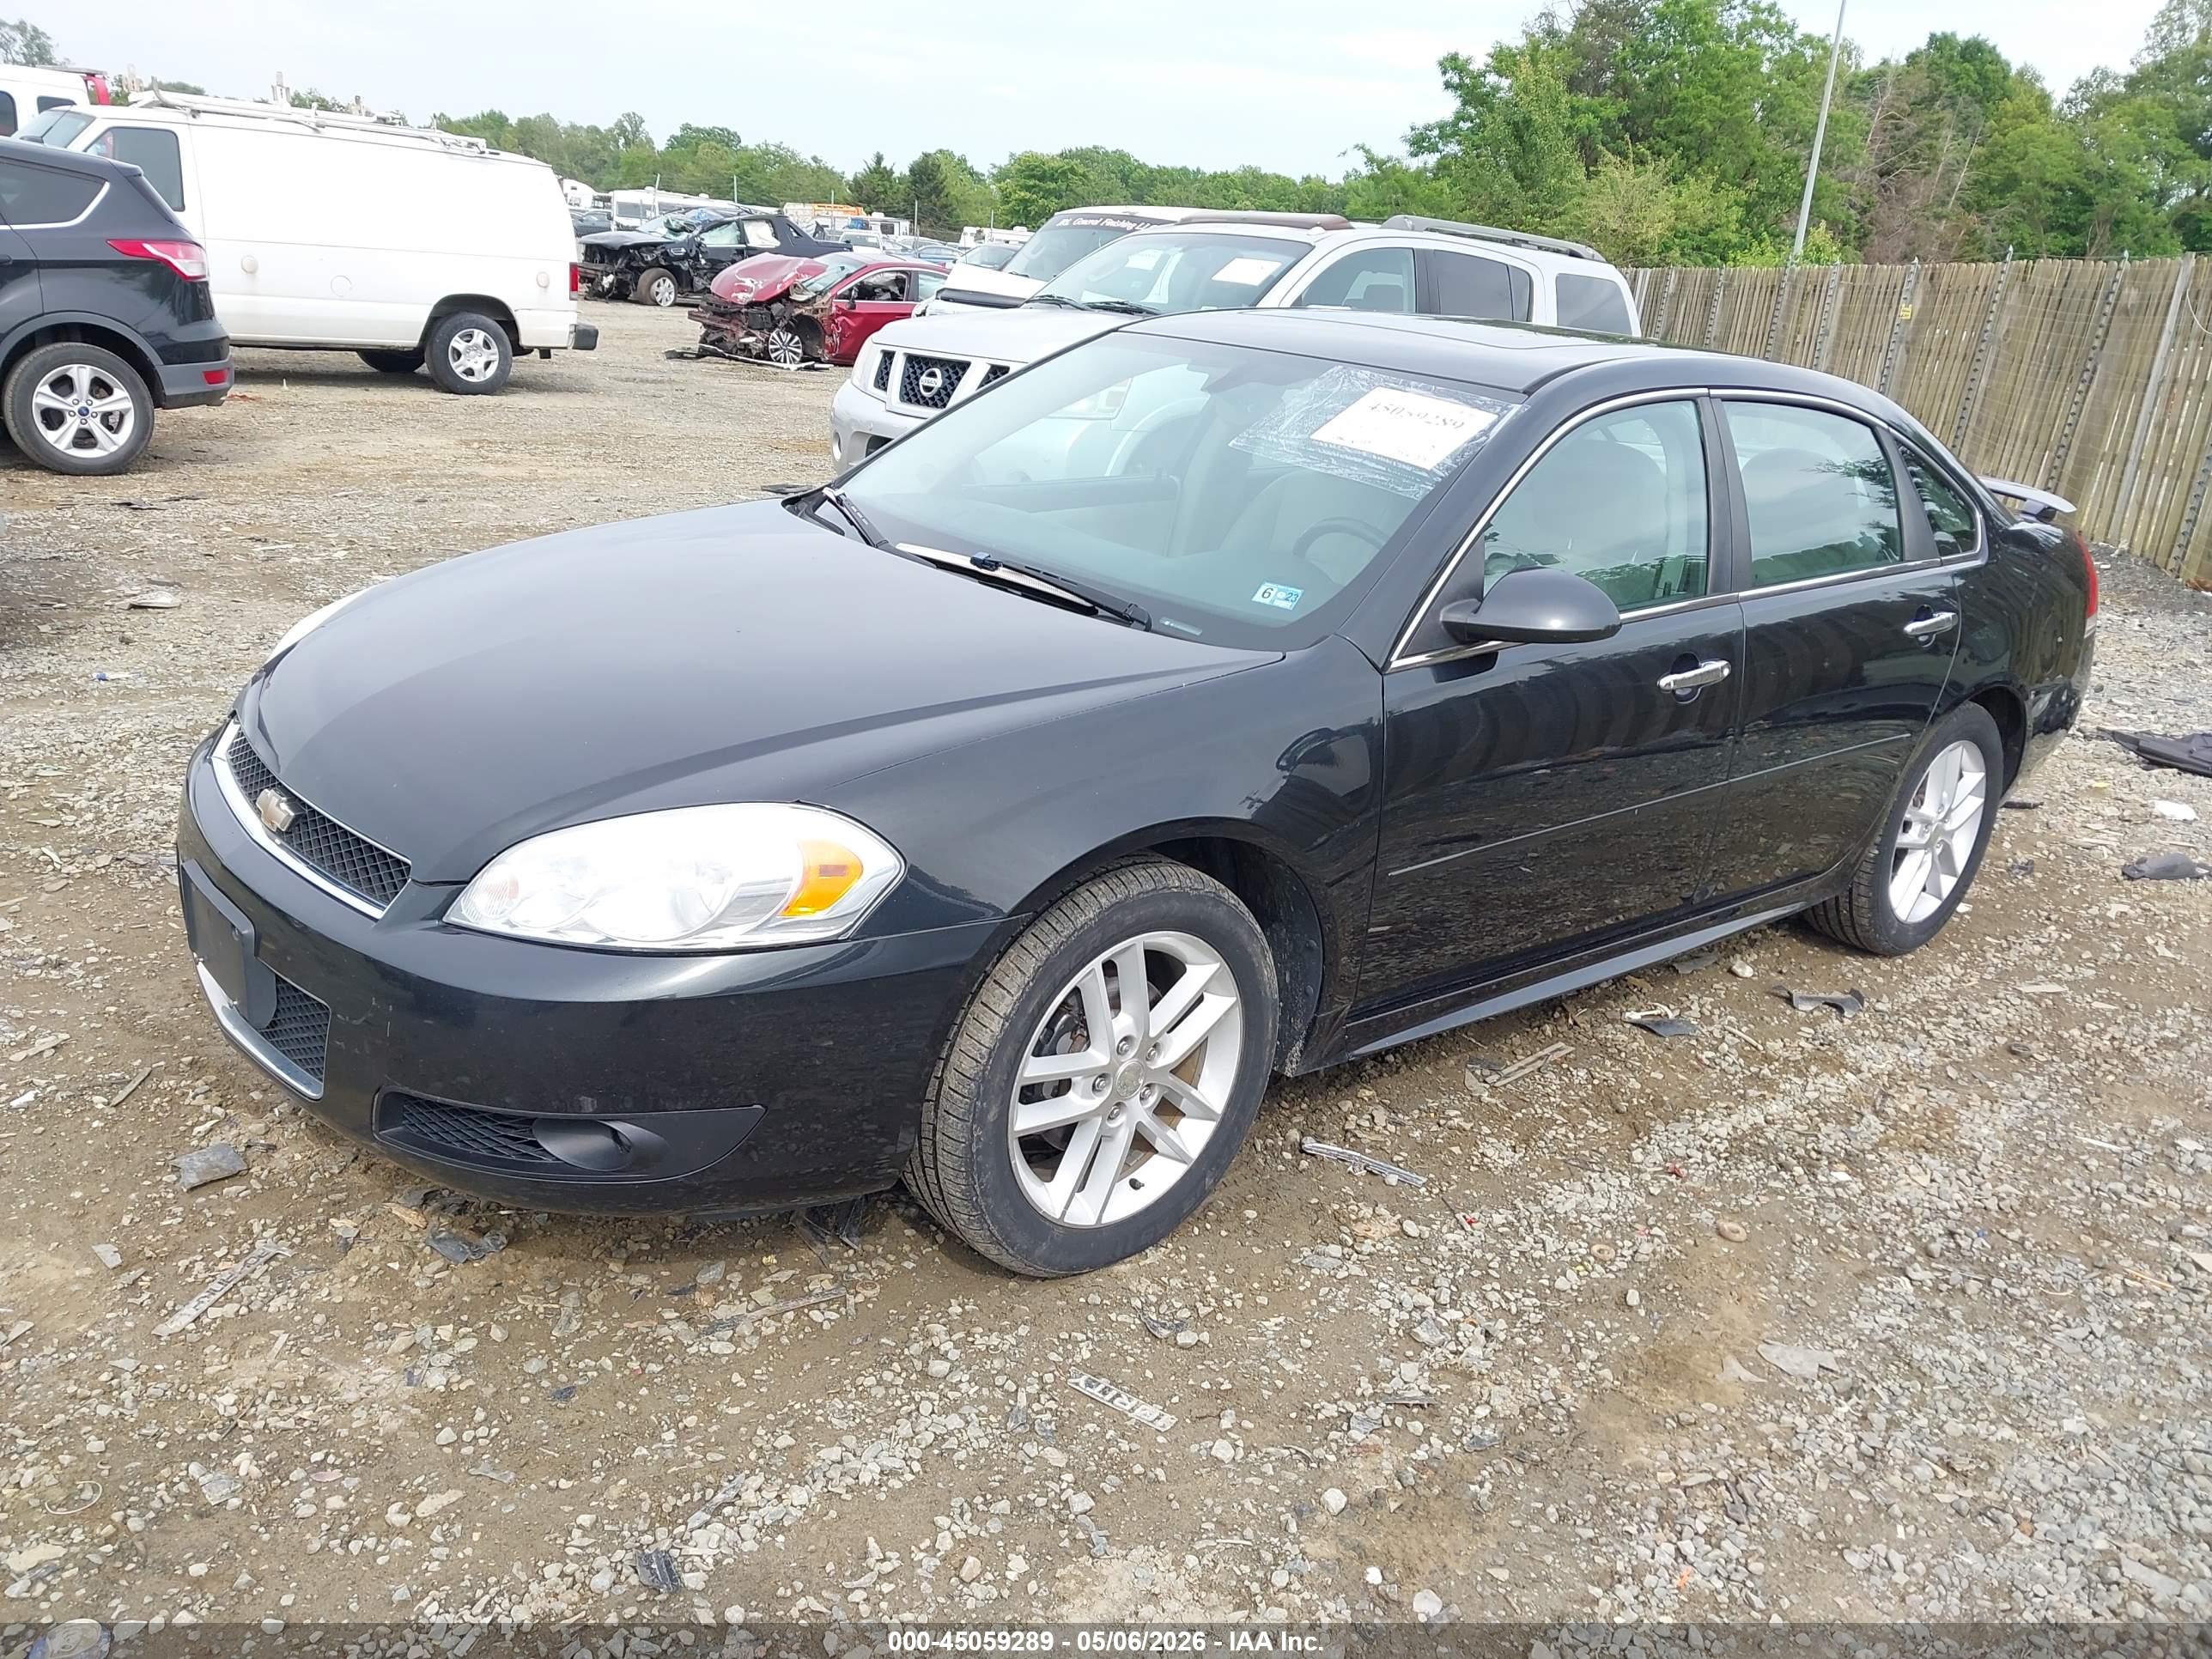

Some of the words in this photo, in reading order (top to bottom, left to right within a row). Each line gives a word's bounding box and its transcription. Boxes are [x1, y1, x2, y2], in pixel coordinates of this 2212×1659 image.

[1073, 217, 1103, 226] General
[1100, 218, 1137, 231] Finishing
[1134, 222, 1151, 230] LL
[1261, 587, 1274, 599] 6
[1285, 592, 1299, 603] 23
